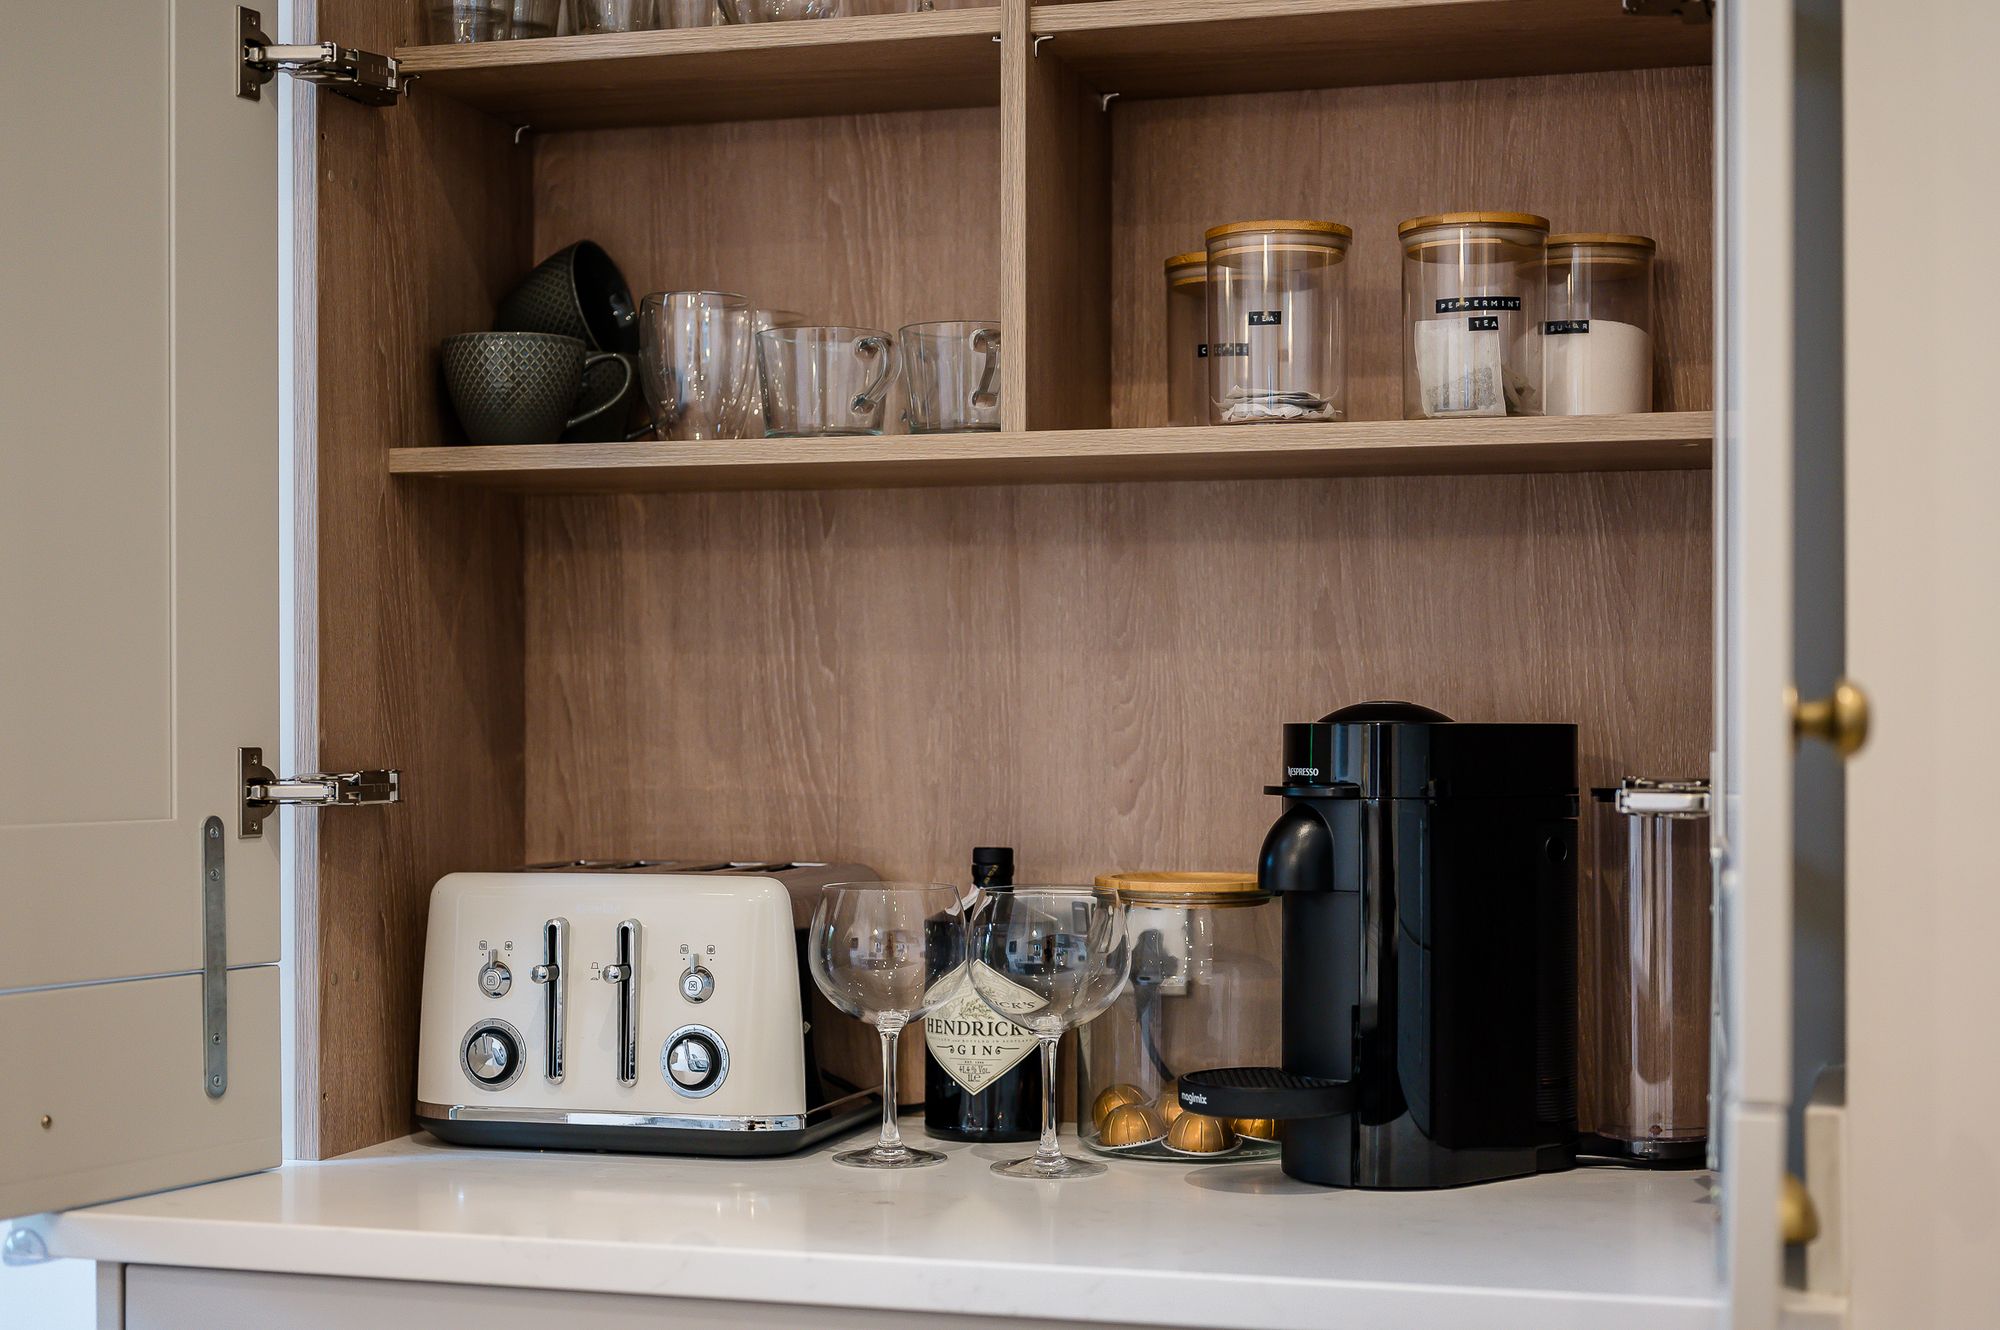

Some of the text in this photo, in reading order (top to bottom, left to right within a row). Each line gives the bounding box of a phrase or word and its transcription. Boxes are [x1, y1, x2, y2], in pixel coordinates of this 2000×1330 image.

[1440, 300, 1520, 310] PEPPERMINT
[1474, 319, 1498, 328] TEA
[1287, 766, 1319, 777] NESPRESSO
[926, 1017, 1036, 1037] HENDRICK
[957, 1045, 993, 1055] GIN
